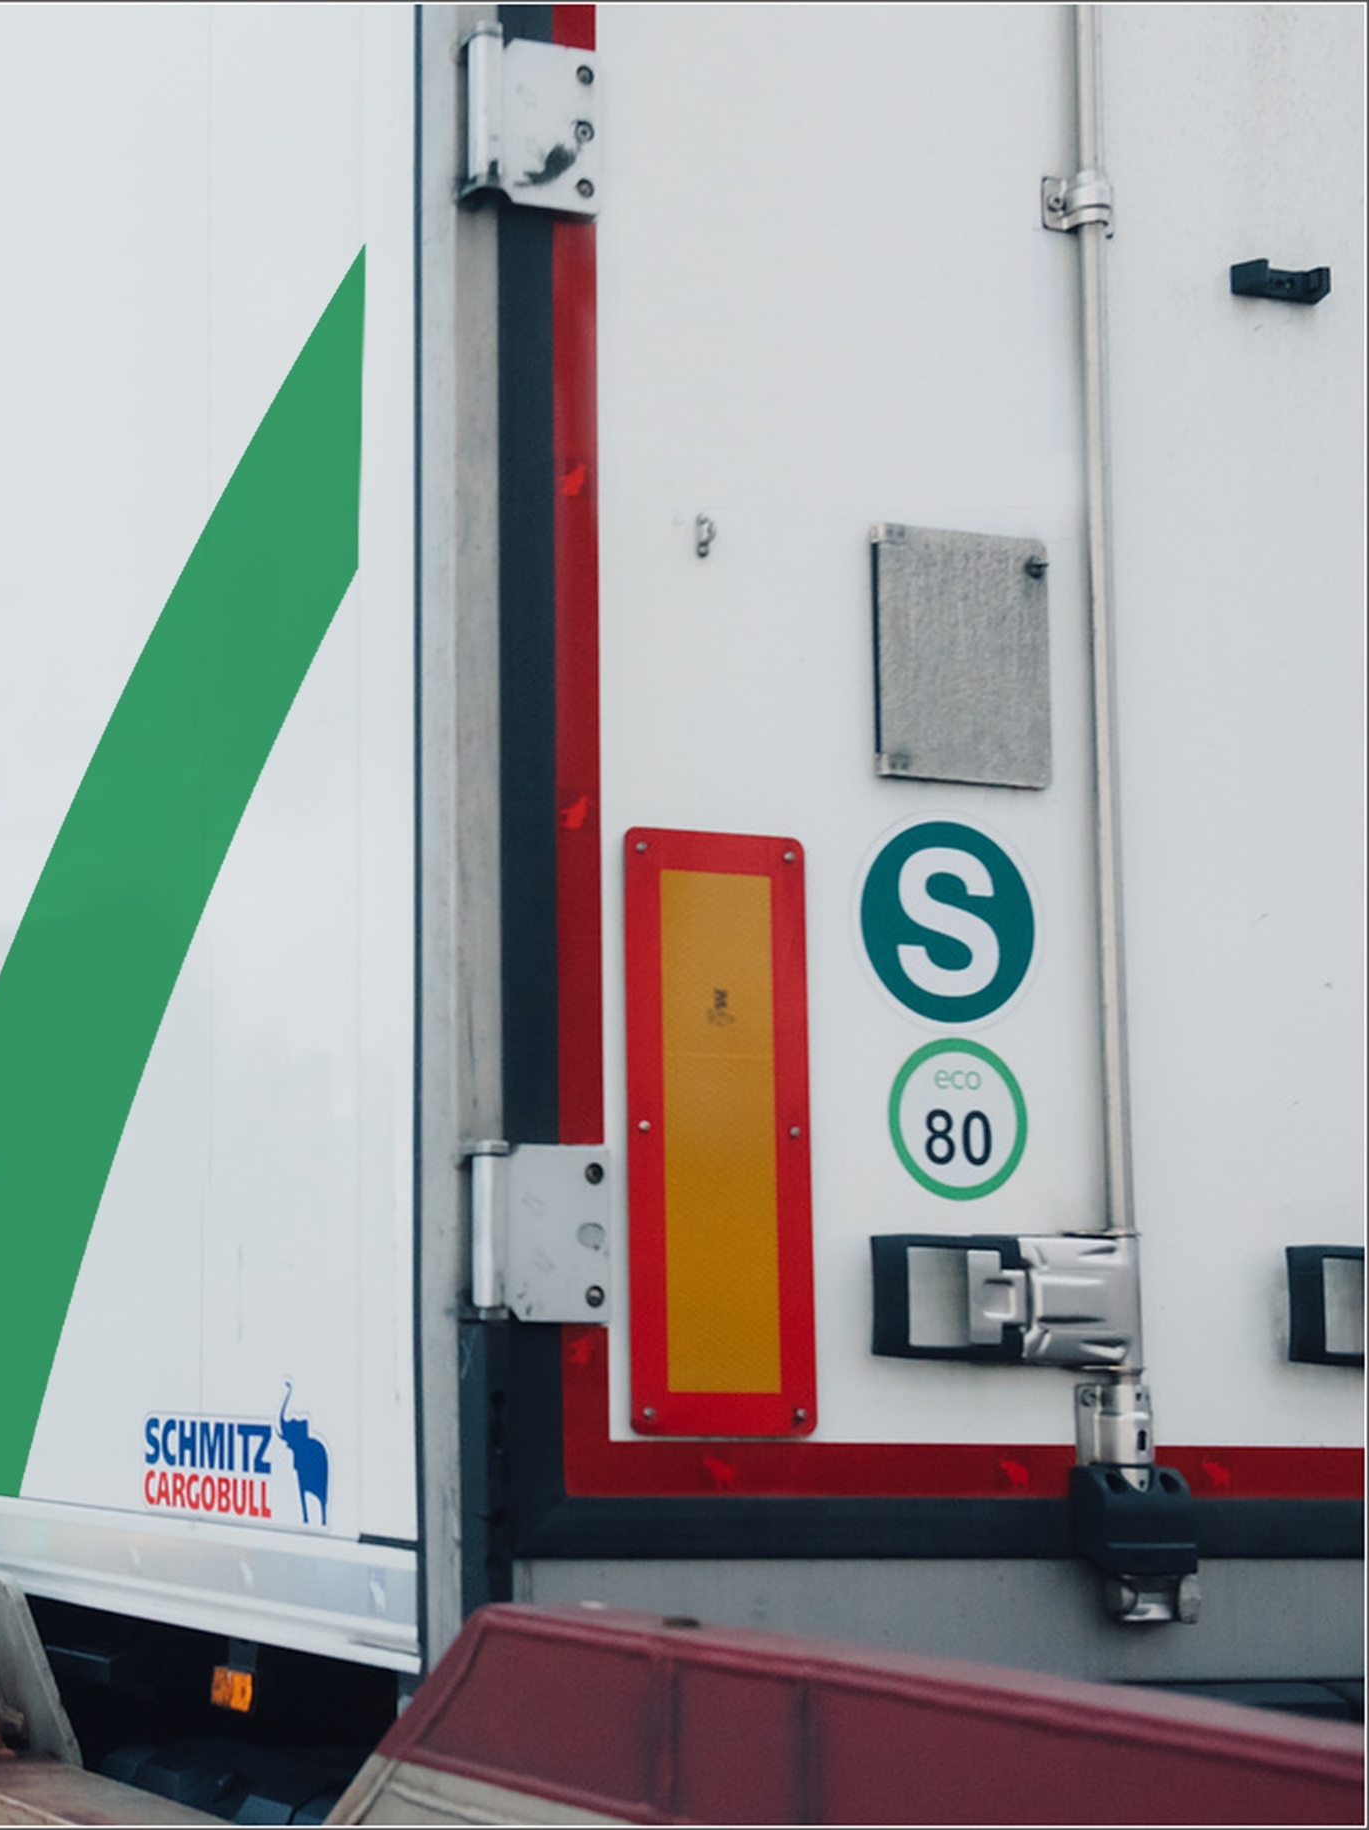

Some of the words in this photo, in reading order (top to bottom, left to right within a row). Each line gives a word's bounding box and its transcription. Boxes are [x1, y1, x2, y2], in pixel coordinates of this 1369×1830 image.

[896, 846, 1000, 997] S
[933, 1069, 981, 1090] eco
[924, 1108, 992, 1166] 80
[144, 1417, 272, 1475] SCHMITZ
[144, 1469, 272, 1518] CARGOBULL
